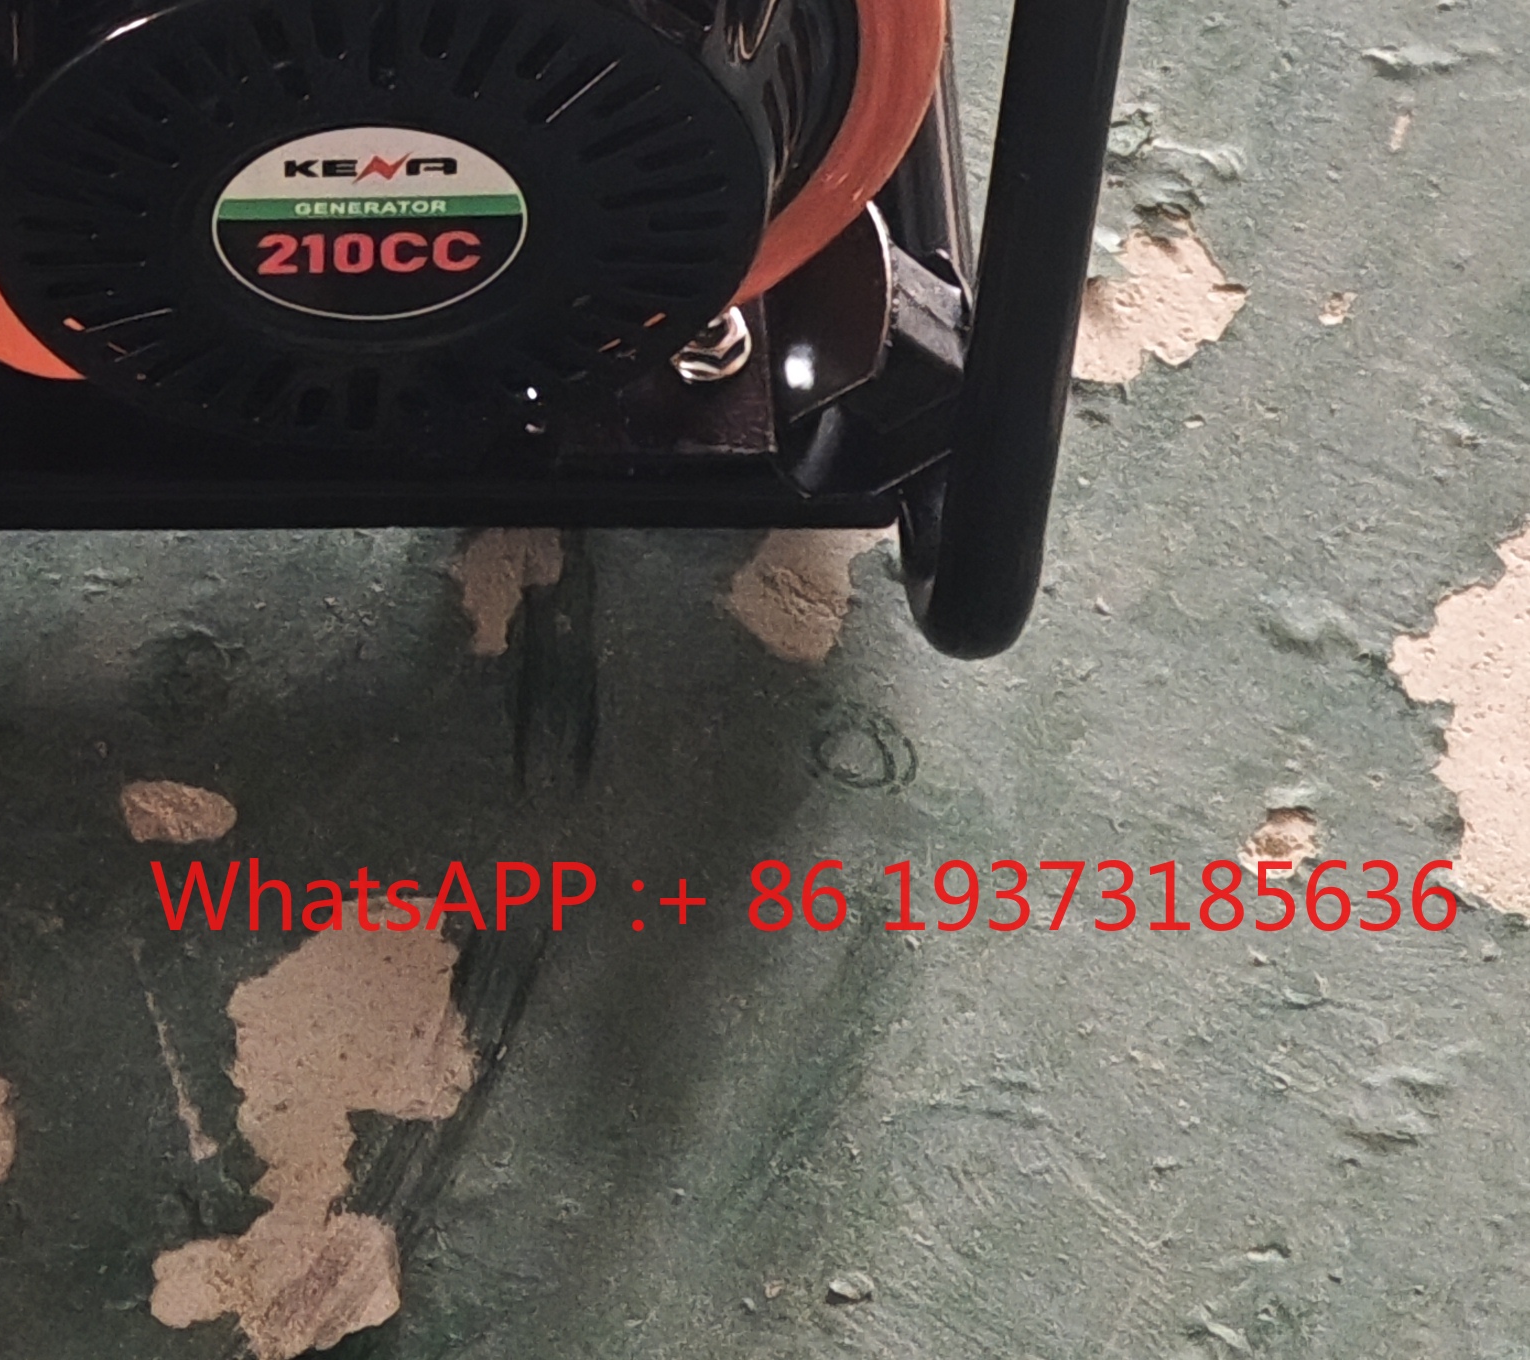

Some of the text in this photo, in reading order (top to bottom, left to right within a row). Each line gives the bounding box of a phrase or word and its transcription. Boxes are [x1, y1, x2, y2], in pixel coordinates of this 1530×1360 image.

[284, 152, 458, 184] KENA
[294, 200, 447, 217] GENERATOR
[258, 232, 481, 274] 210CC
